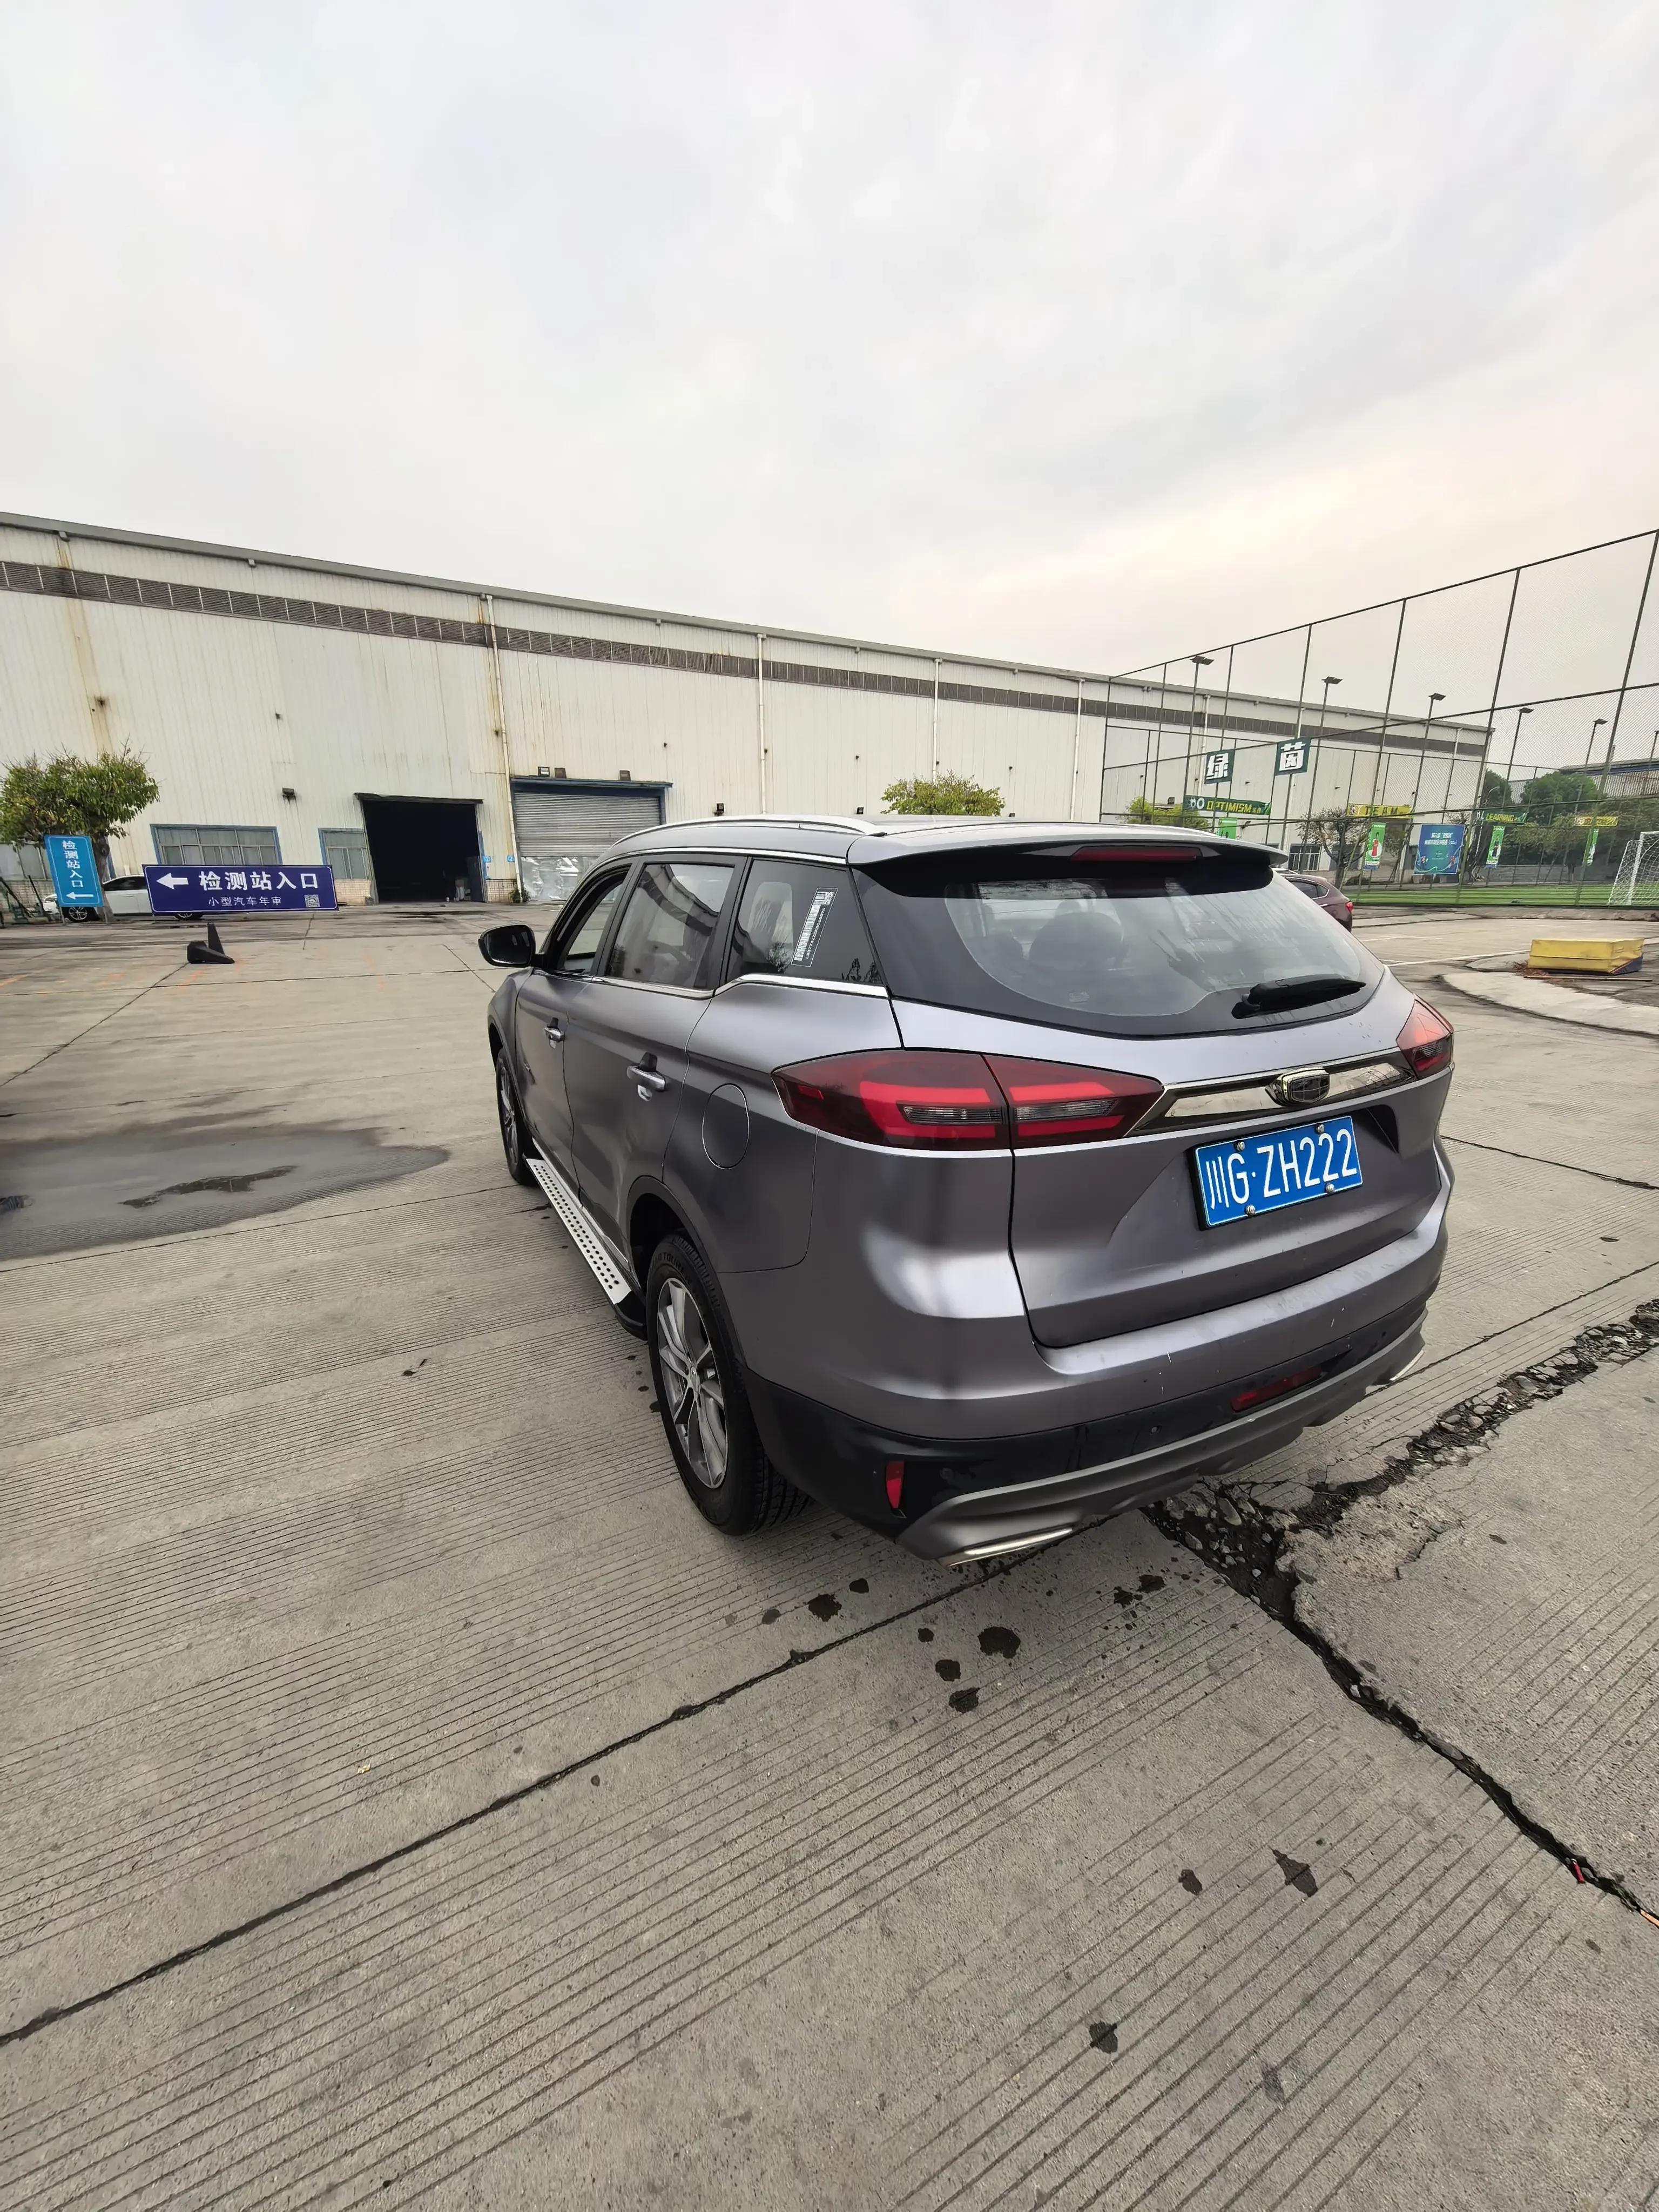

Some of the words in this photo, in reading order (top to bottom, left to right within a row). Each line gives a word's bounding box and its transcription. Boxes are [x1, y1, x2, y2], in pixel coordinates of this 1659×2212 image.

[1206, 753, 1229, 780] 绿
[1279, 741, 1306, 772] 茵
[1206, 800, 1252, 813] OPTIMISM
[1365, 806, 1398, 815] TEAM
[62, 840, 83, 888] 检测站入口
[198, 871, 319, 891] 检测站入口
[208, 896, 282, 907] 小型汽车年审
[1205, 1128, 1358, 1210] 川G·ZH222
